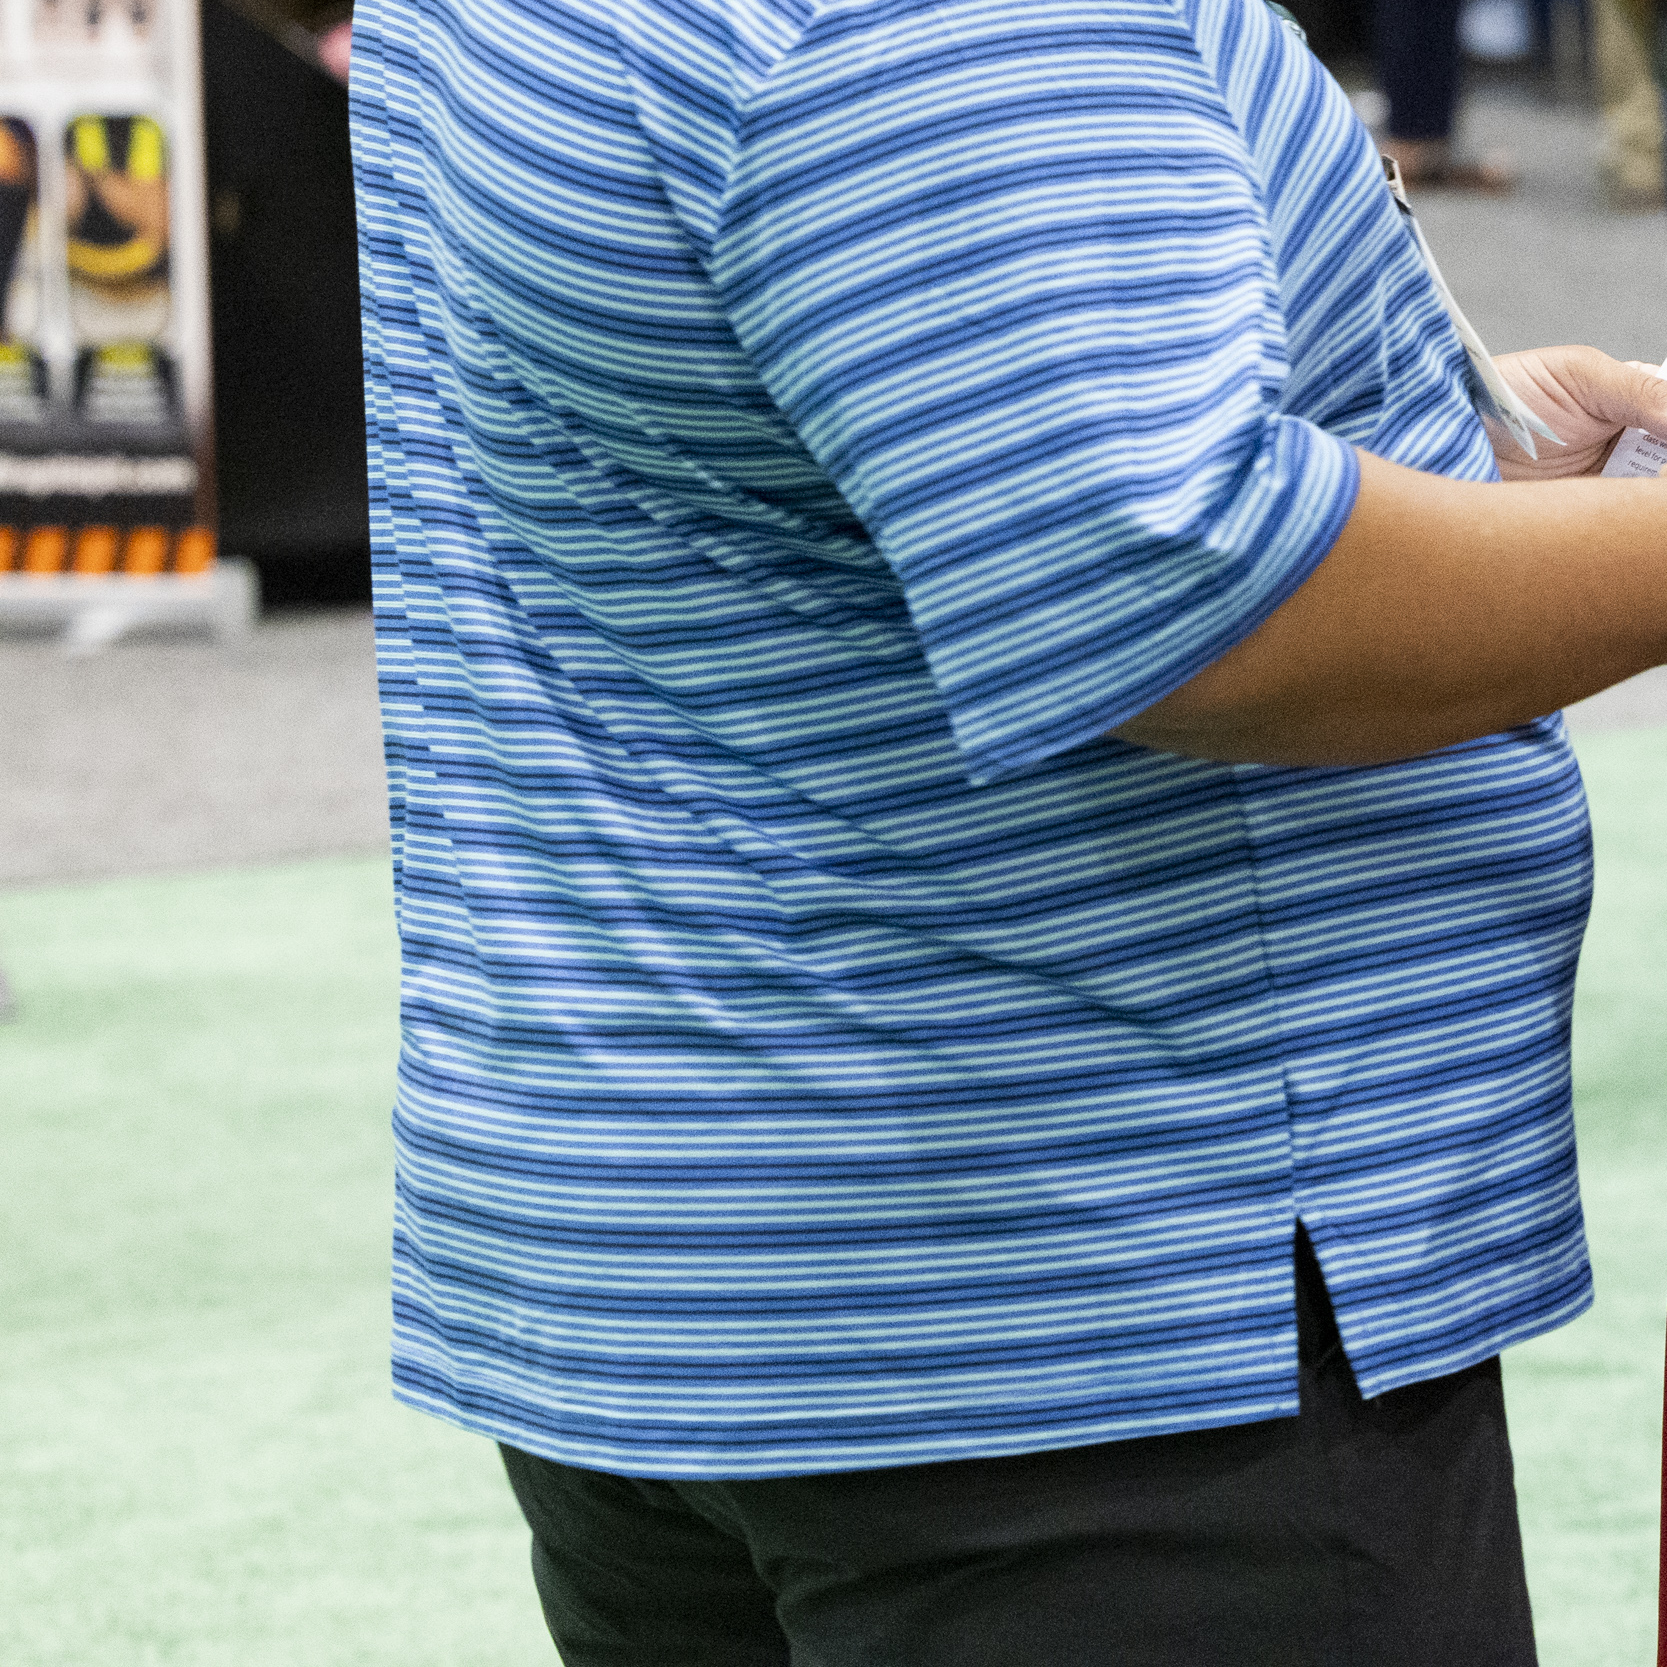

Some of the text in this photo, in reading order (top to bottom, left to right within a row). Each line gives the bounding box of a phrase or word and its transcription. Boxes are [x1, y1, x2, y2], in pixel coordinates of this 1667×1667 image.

[1642, 433, 1659, 446] class
[1635, 445, 1662, 463] level for
[1627, 459, 1658, 474] requirem
